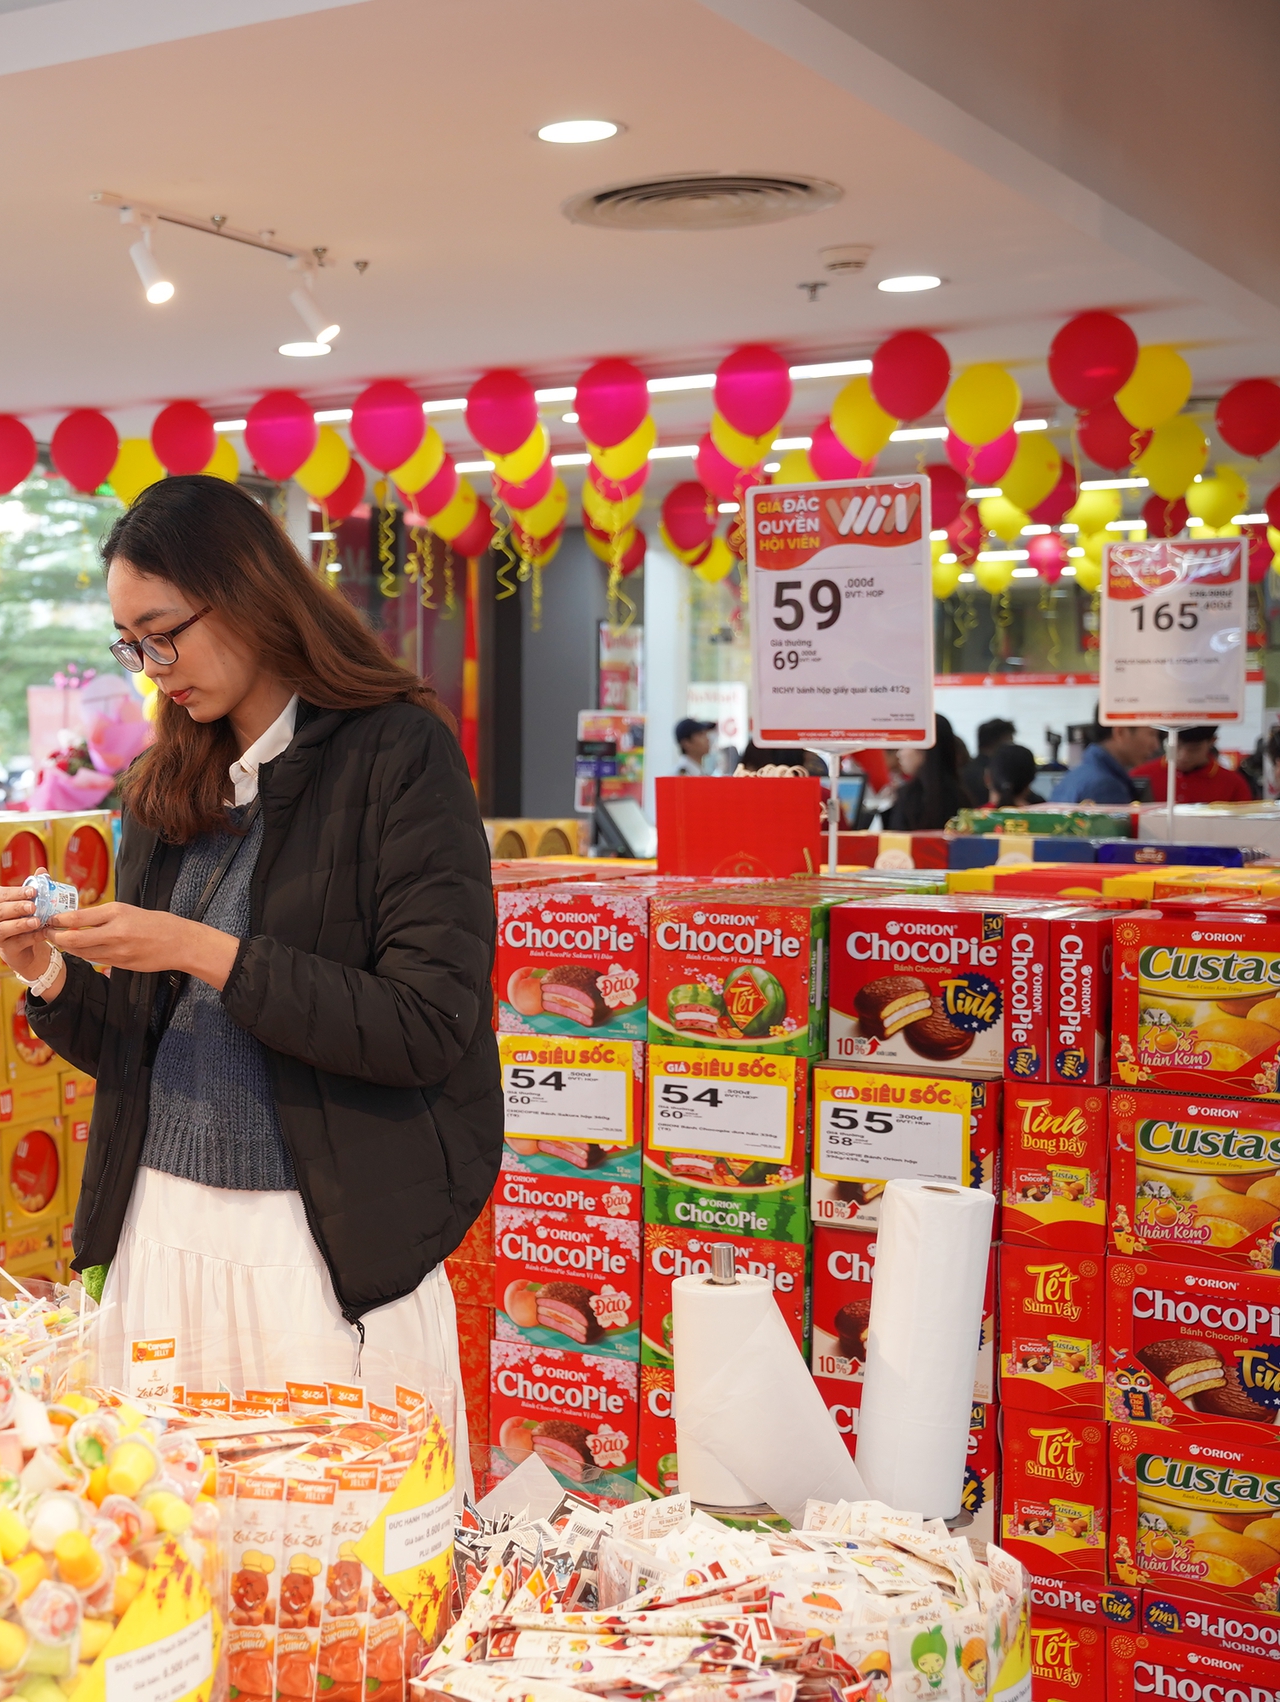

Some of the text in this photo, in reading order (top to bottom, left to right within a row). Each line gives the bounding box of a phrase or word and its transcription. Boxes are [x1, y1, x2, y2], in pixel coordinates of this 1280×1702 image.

[787, 536, 819, 549] VIÊN
[773, 579, 842, 631] 59
[1131, 603, 1198, 631] 165
[773, 651, 799, 670] 69
[555, 912, 598, 923] ORION
[709, 913, 755, 926] ORION
[505, 920, 634, 951] ChocoPie
[903, 922, 954, 936] ORION
[1204, 932, 1243, 943] ORION
[656, 922, 800, 957] ChocoPie
[846, 931, 998, 966] ChocoPie
[602, 977, 634, 997] Đào
[1011, 933, 1034, 1043] ChocoPie
[1033, 975, 1043, 1013] ORION
[1059, 934, 1084, 1045] ChocoPie
[1081, 977, 1092, 1015] ORION
[730, 986, 758, 1014] Tết
[515, 1044, 615, 1064] GIÁ SIÊU SỐC
[836, 1038, 854, 1056] 10
[666, 1056, 777, 1077] GIÁ SIÊU SỐC
[1175, 1053, 1211, 1065] Kem
[510, 1068, 566, 1091] 54
[509, 1095, 530, 1104] 60
[661, 1084, 723, 1108] 54
[834, 1082, 952, 1104] GIÁ SIÊU SỐC
[660, 1110, 683, 1119] 60
[829, 1107, 894, 1134] 55
[1200, 1108, 1239, 1118] ORION
[828, 1135, 853, 1146] 58
[503, 1182, 596, 1211] ChocoPie
[675, 1202, 768, 1231] ChocoPie
[816, 1200, 834, 1218] 10
[550, 1228, 590, 1243] ORION
[1174, 1226, 1209, 1239] Kem
[501, 1232, 626, 1274] ChocoPie
[1026, 1263, 1078, 1302] Tết
[1198, 1278, 1237, 1291] ORION
[592, 1294, 630, 1317] Đào
[1024, 1299, 1053, 1314] Sum
[1133, 1287, 1280, 1338] ChocoPi
[1180, 1326, 1249, 1344] Bánh ChocoPie
[818, 1355, 836, 1372] 10
[546, 1367, 588, 1383] ORION
[497, 1370, 624, 1414] ChocoPie
[591, 1437, 624, 1454] Đào
[1029, 1428, 1082, 1466] Tết
[1202, 1448, 1241, 1462] ORION
[1026, 1461, 1055, 1478] Sum
[1171, 1560, 1207, 1575] Kem
[1031, 1589, 1097, 1614] coPie
[1032, 1665, 1053, 1678] um
[1201, 1656, 1242, 1672] ORION
